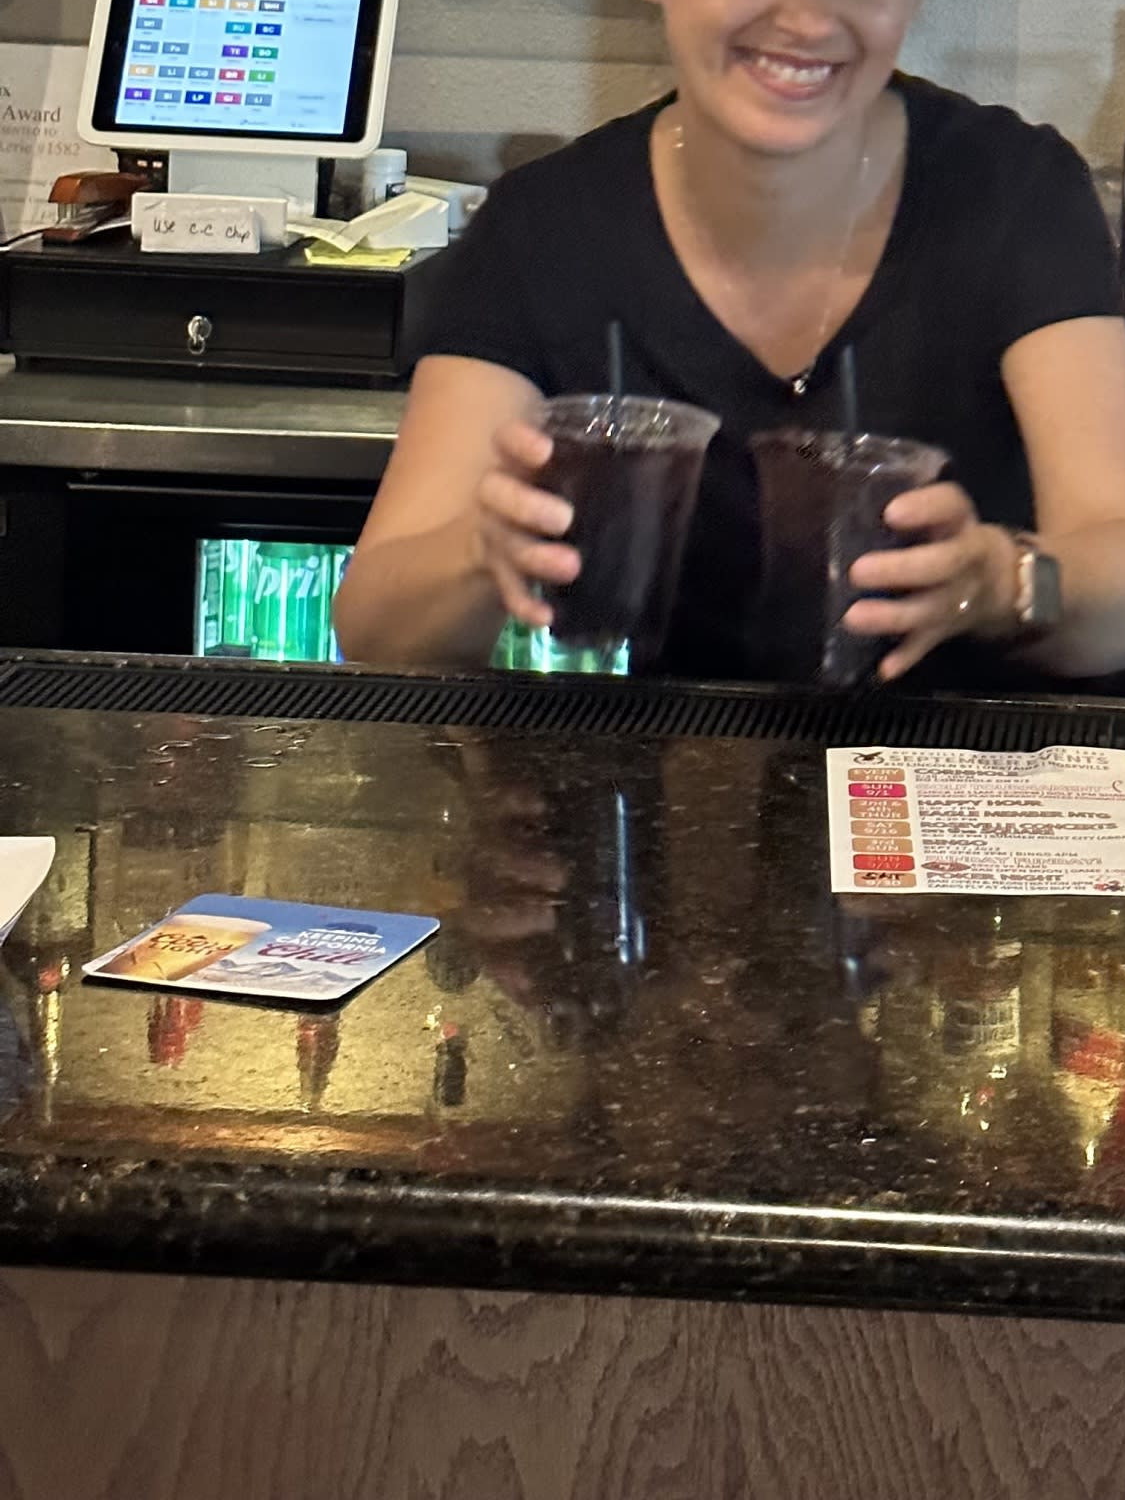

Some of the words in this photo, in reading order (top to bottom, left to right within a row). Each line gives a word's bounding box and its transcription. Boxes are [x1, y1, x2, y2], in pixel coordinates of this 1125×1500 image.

[2, 105, 61, 123] Award
[888, 755, 1021, 766] SEPTEMBER
[1026, 753, 1110, 765] EVENTS
[1019, 823, 1118, 831] CONCERTS
[927, 872, 994, 880] POKER
[1000, 874, 1064, 882] NIGHT
[275, 935, 387, 954] CALIFORNIA
[298, 930, 379, 946] KEEPING
[257, 943, 376, 966] Chill
